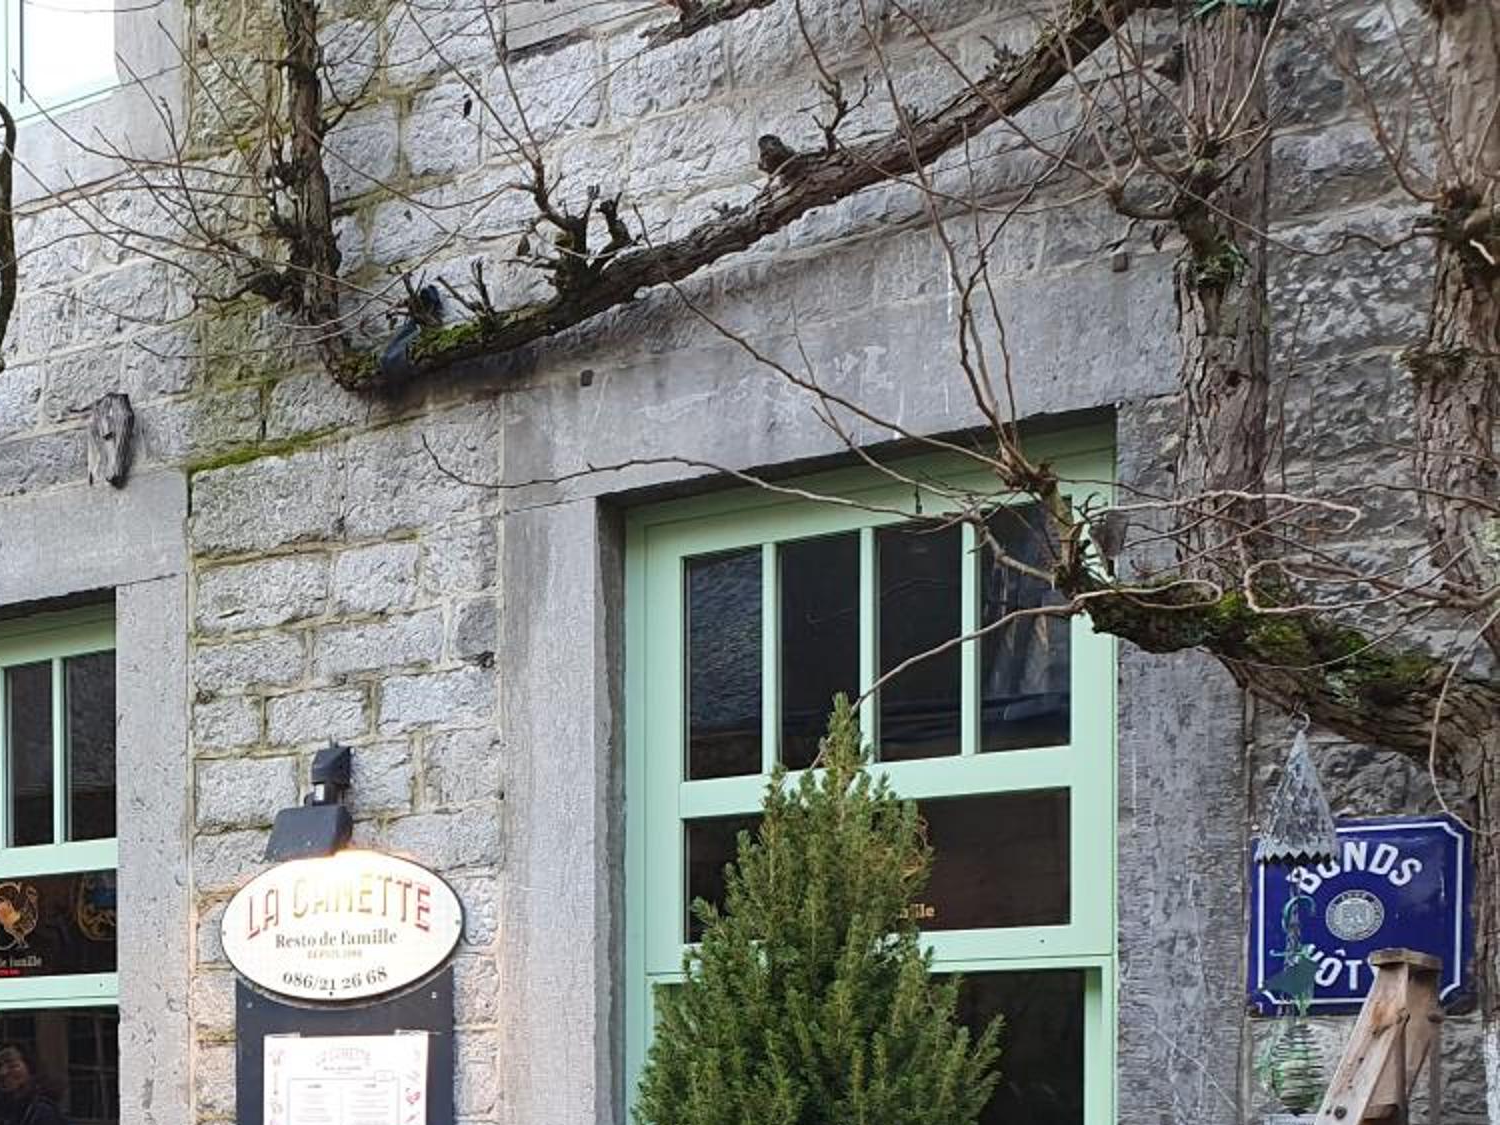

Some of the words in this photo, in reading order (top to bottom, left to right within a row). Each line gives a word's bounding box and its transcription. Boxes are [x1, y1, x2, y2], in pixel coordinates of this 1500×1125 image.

[247, 888, 279, 940] LA
[293, 873, 432, 934] CANETTE
[276, 932, 317, 949] Resto
[320, 930, 337, 946] de
[341, 928, 398, 945] famille
[282, 971, 336, 991] 086/21
[341, 973, 362, 989] 26
[366, 966, 389, 986] 68
